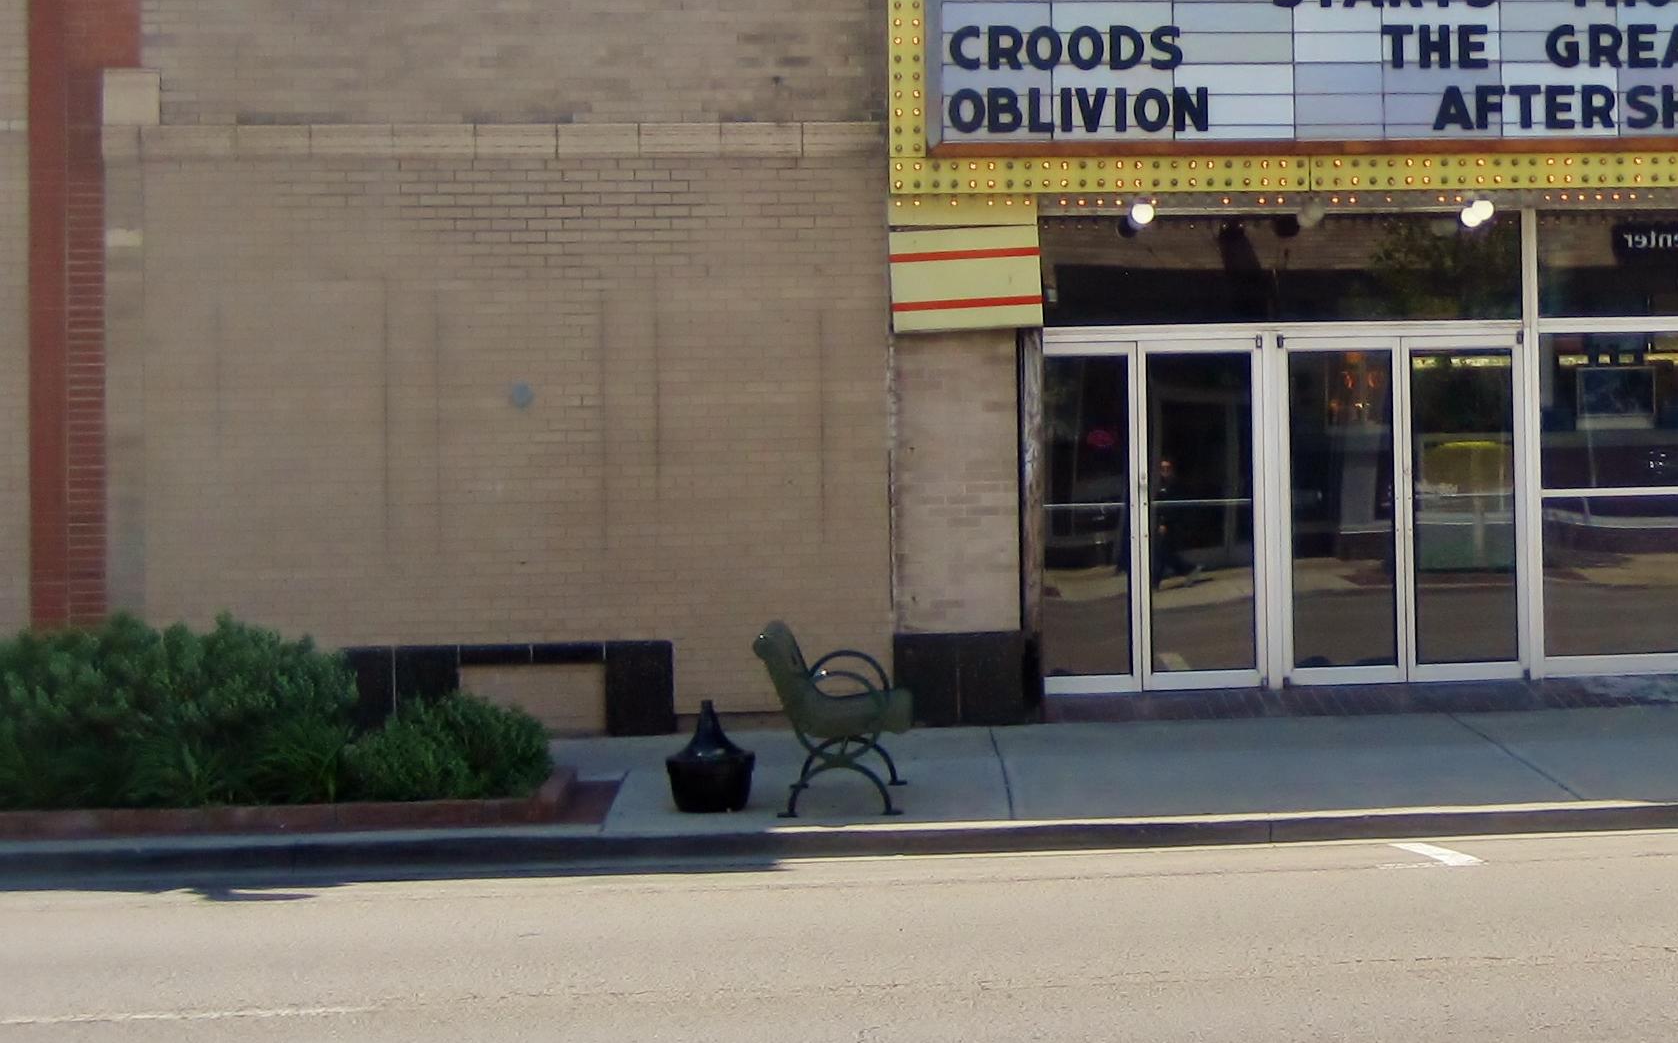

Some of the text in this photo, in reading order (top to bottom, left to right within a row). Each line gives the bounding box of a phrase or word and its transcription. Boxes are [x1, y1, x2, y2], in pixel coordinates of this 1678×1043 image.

[948, 25, 1184, 72] CROODS
[1380, 24, 1489, 70] THE
[948, 87, 1209, 134] OBLIVION
